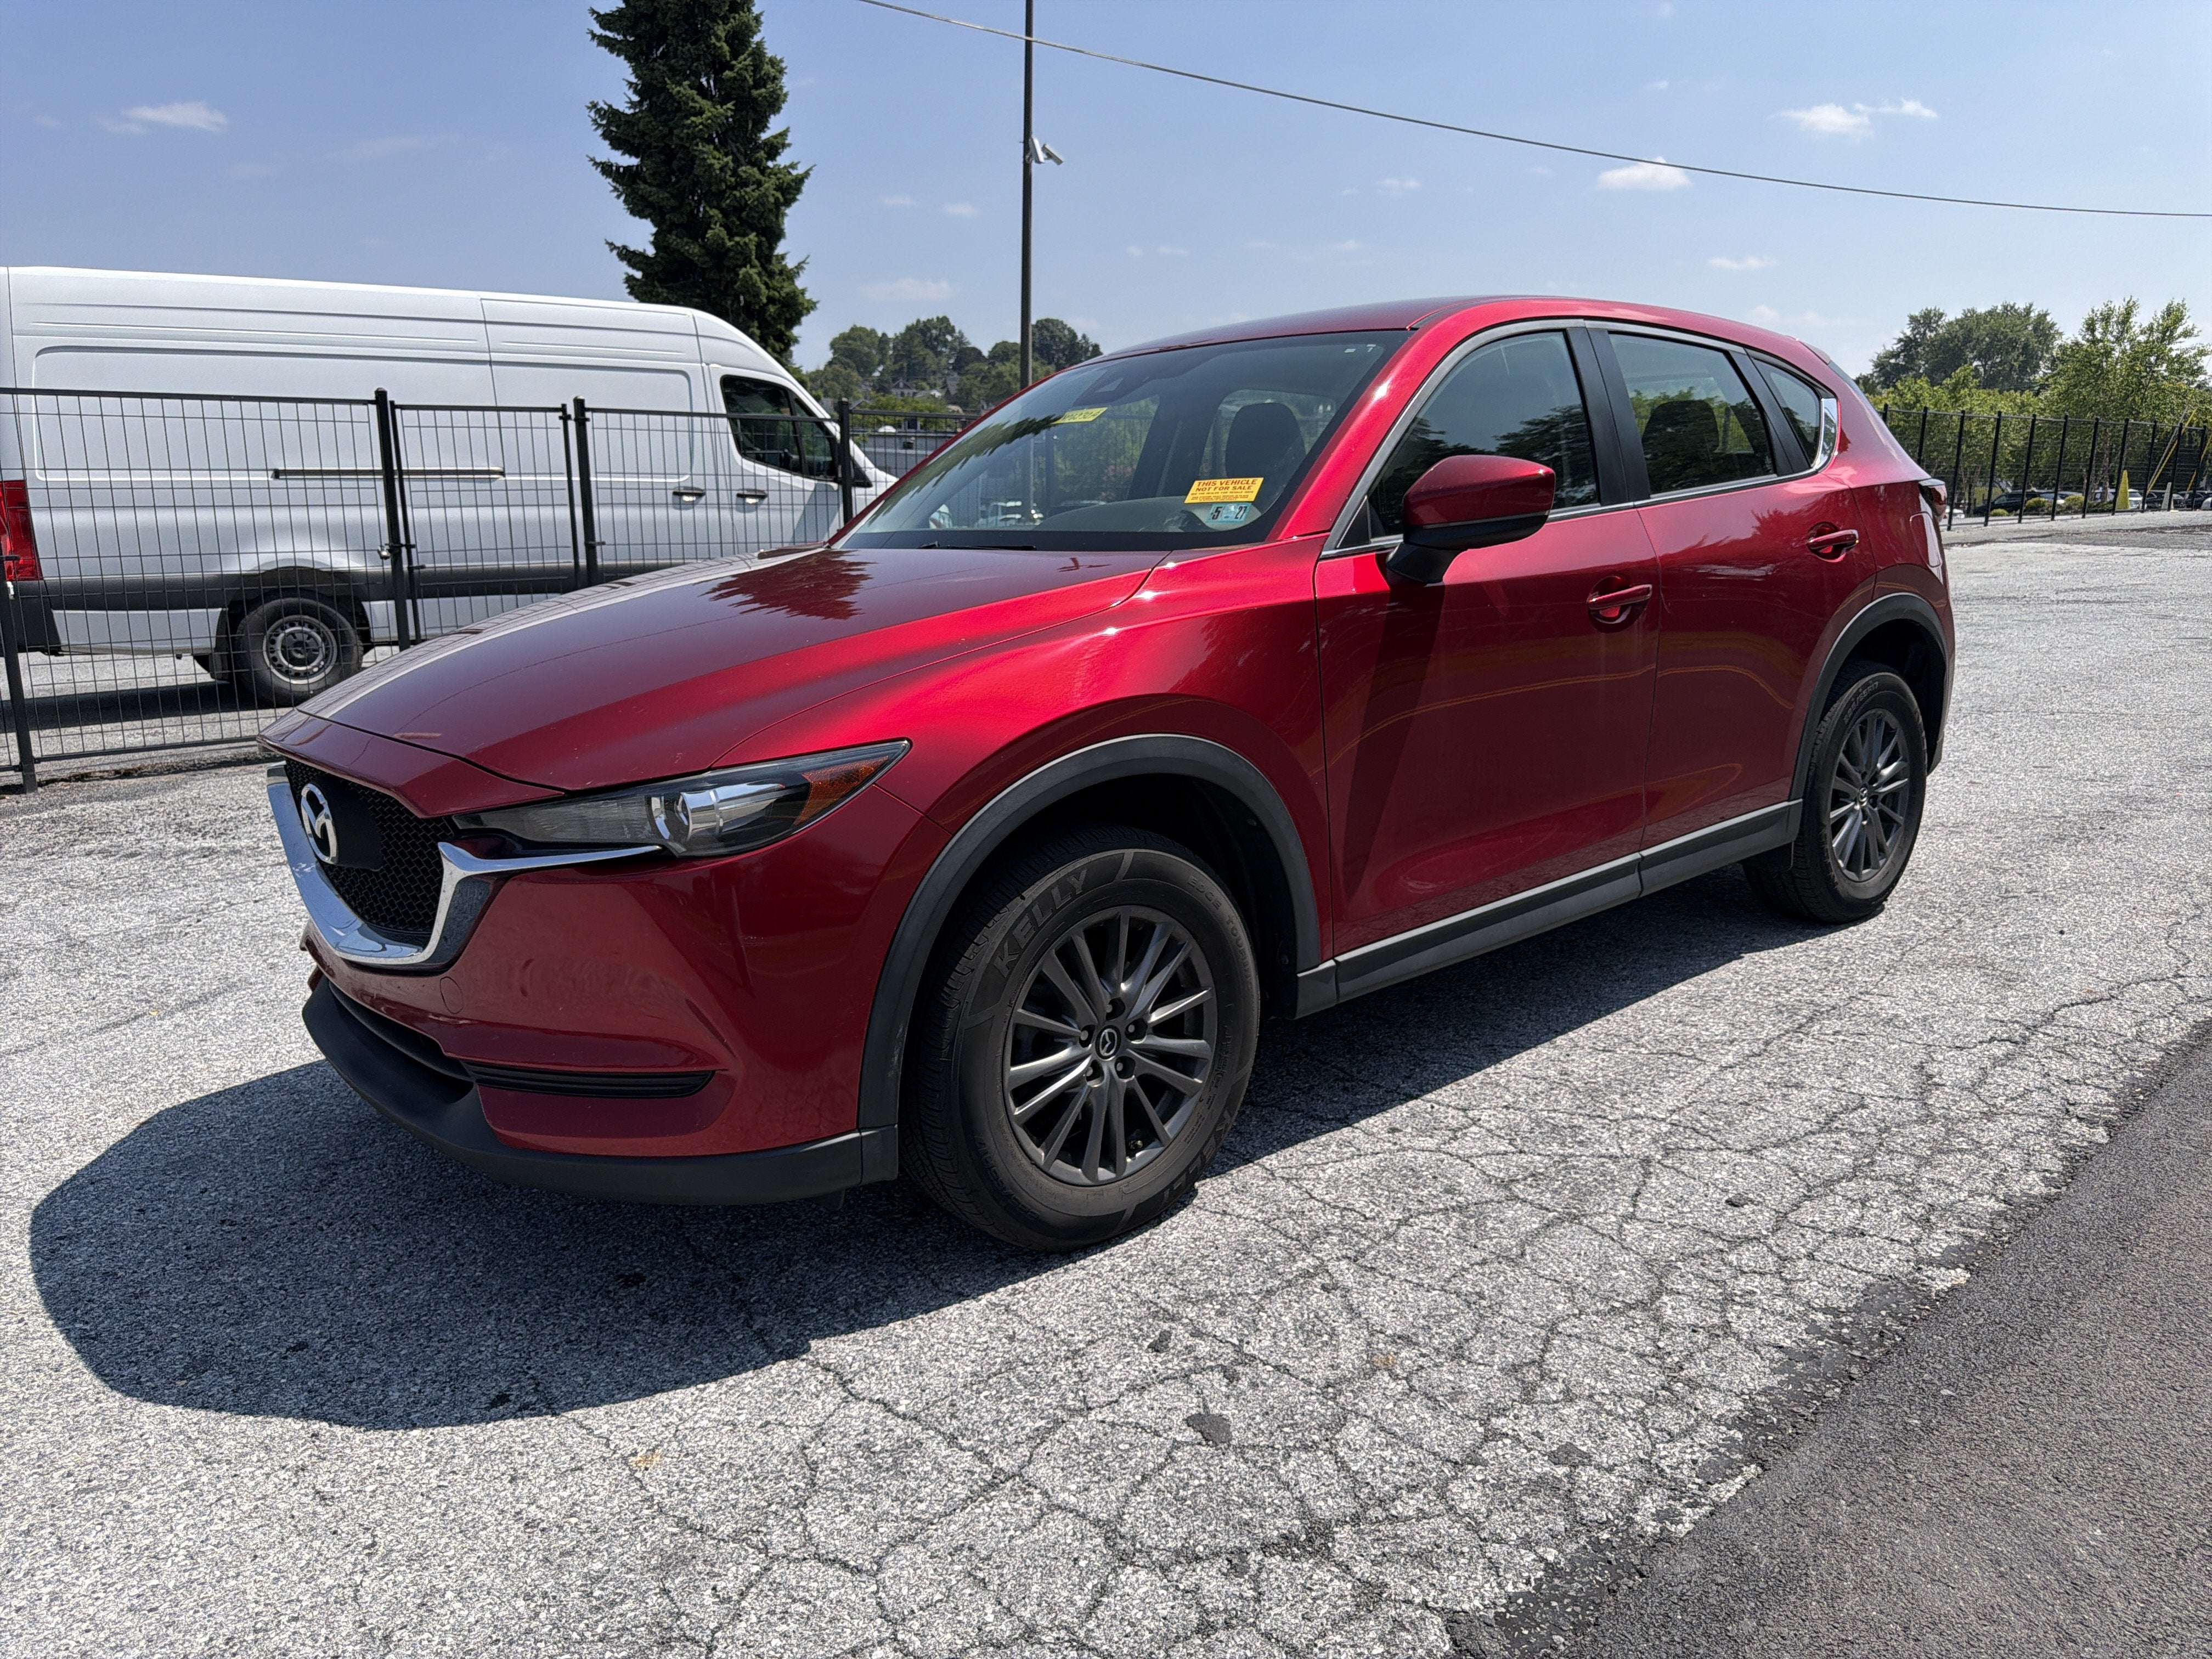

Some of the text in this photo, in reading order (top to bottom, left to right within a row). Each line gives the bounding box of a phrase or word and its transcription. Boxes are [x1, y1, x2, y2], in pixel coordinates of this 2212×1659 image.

[1234, 506, 1248, 520] 27
[1187, 874, 1222, 911] EDGE
[994, 868, 1089, 978] KELLY
